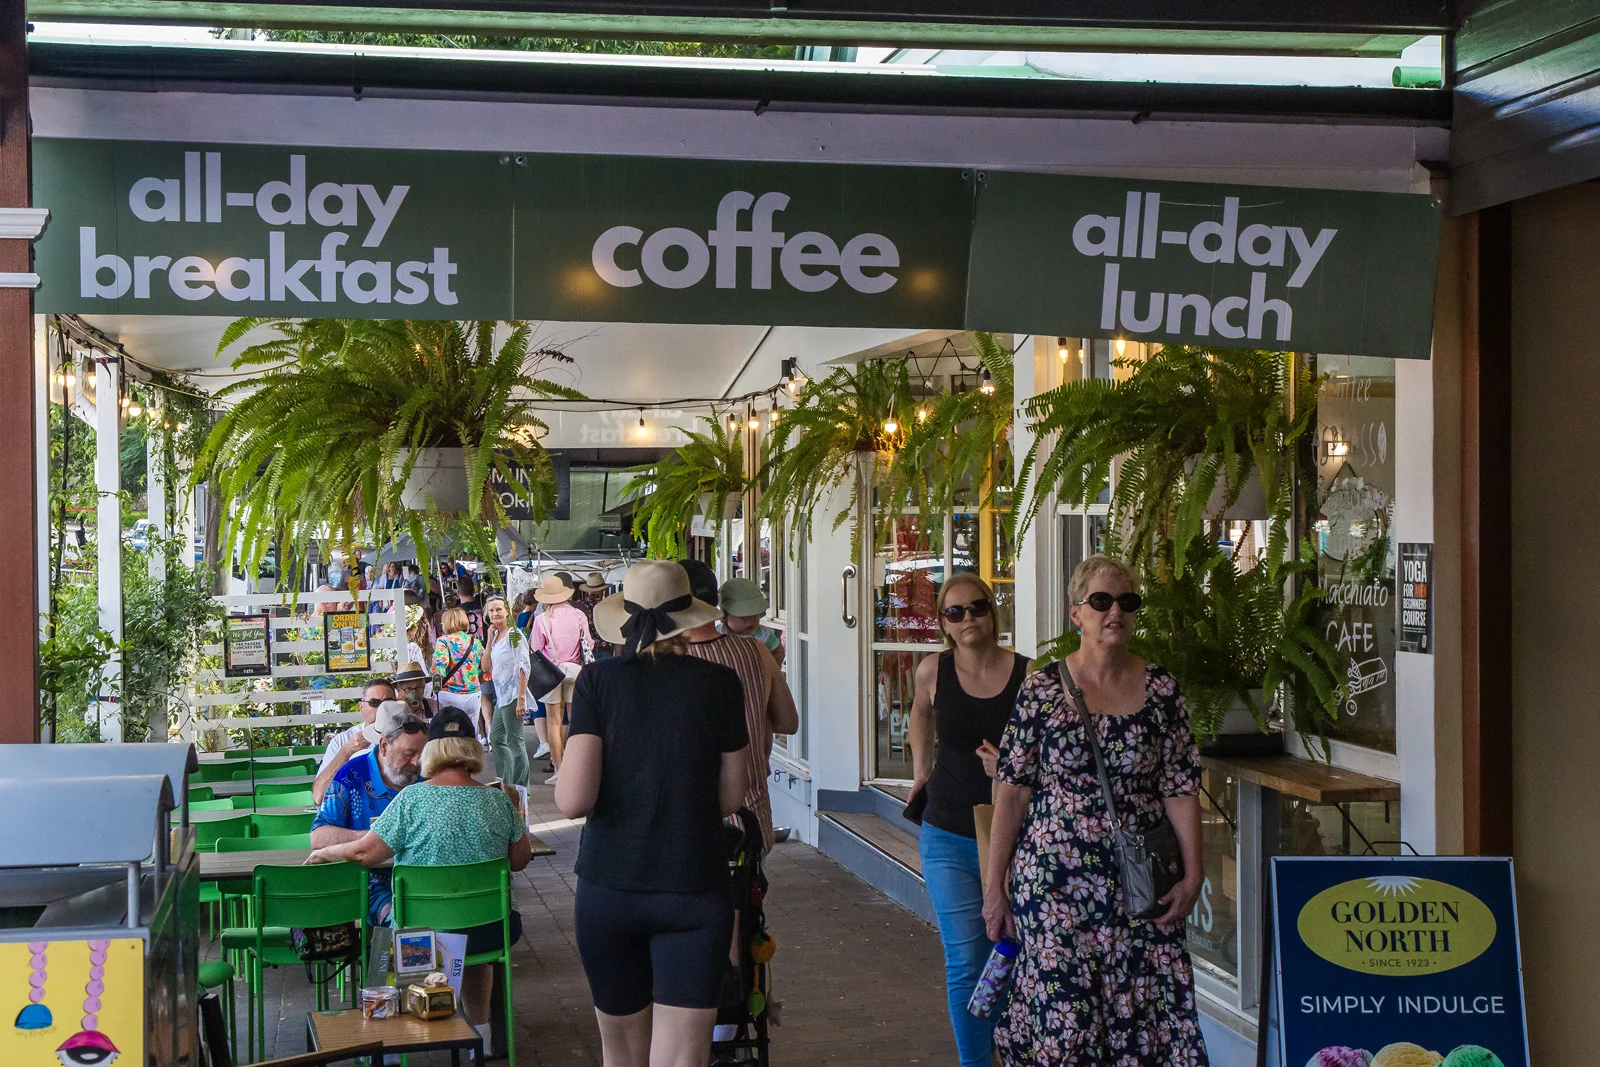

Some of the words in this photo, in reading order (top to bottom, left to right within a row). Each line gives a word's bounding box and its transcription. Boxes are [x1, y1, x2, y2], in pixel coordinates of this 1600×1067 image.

[129, 151, 410, 248] all-day
[592, 190, 900, 294] coffee
[1072, 190, 1338, 288] all-day
[79, 226, 459, 306] breakfast
[1100, 262, 1293, 342] lunch
[1403, 560, 1427, 582] YOGA
[1317, 577, 1389, 607] Macchiato
[1403, 583, 1414, 597] FOR
[1402, 598, 1427, 610] BEGINNERS
[332, 613, 360, 622] ORDER
[332, 620, 362, 629] ONLINE
[1402, 610, 1426, 626] COURSE
[1326, 620, 1374, 653] CAFE
[1330, 900, 1460, 924] GOLDEN
[1344, 929, 1452, 953] NORTH
[452, 958, 463, 977] EATS
[1369, 958, 1402, 968] SINCE
[1406, 958, 1430, 968] 1923
[1300, 995, 1386, 1014] SIMPLY
[1398, 996, 1505, 1014] INDULGE
